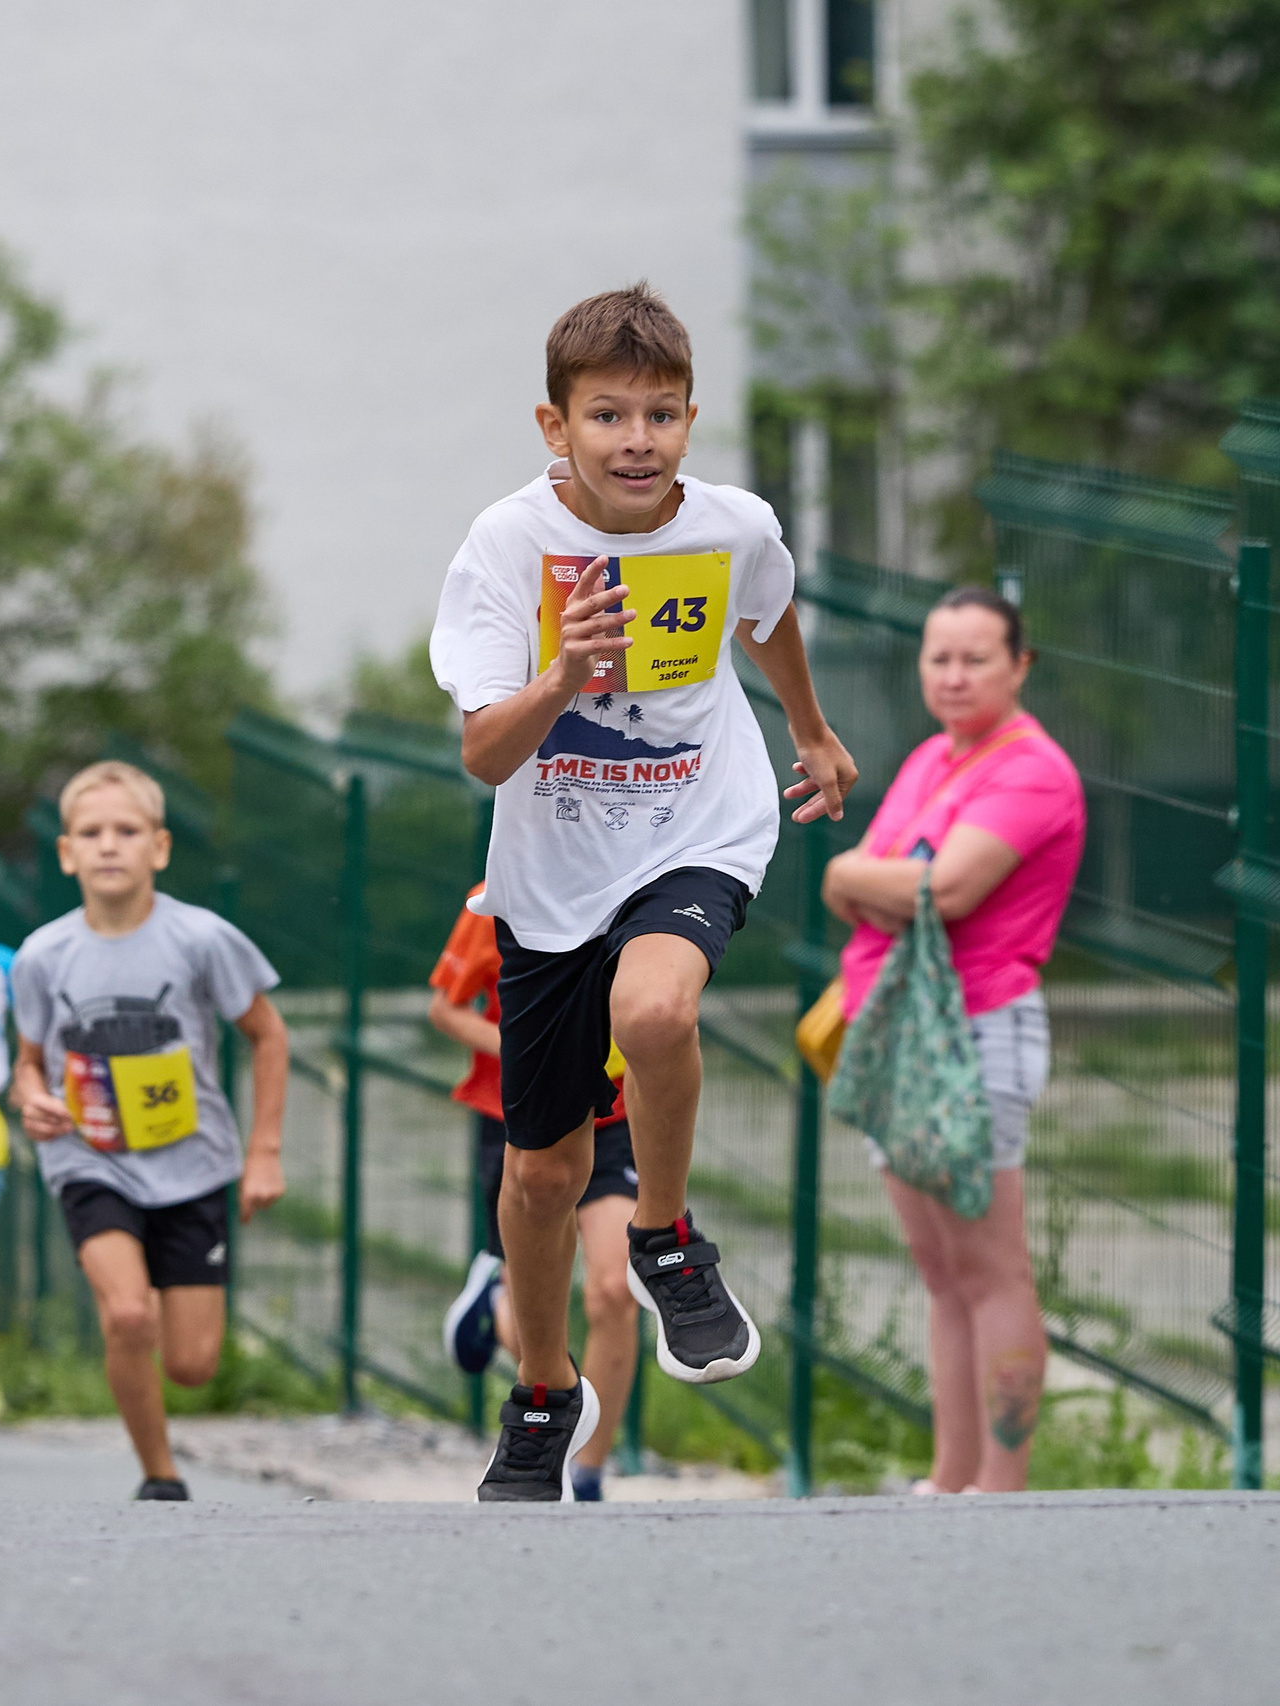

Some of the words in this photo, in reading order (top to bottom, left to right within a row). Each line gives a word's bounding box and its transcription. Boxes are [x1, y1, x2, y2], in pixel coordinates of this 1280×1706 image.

[650, 596, 708, 633] 43
[650, 654, 699, 670] Детский
[658, 670, 690, 681] забег
[536, 757, 597, 781] TME
[602, 764, 628, 782] IS
[632, 751, 702, 782] NOW!
[140, 1080, 179, 1109] 36
[657, 1251, 685, 1267] GSD
[523, 1411, 551, 1423] GSD
